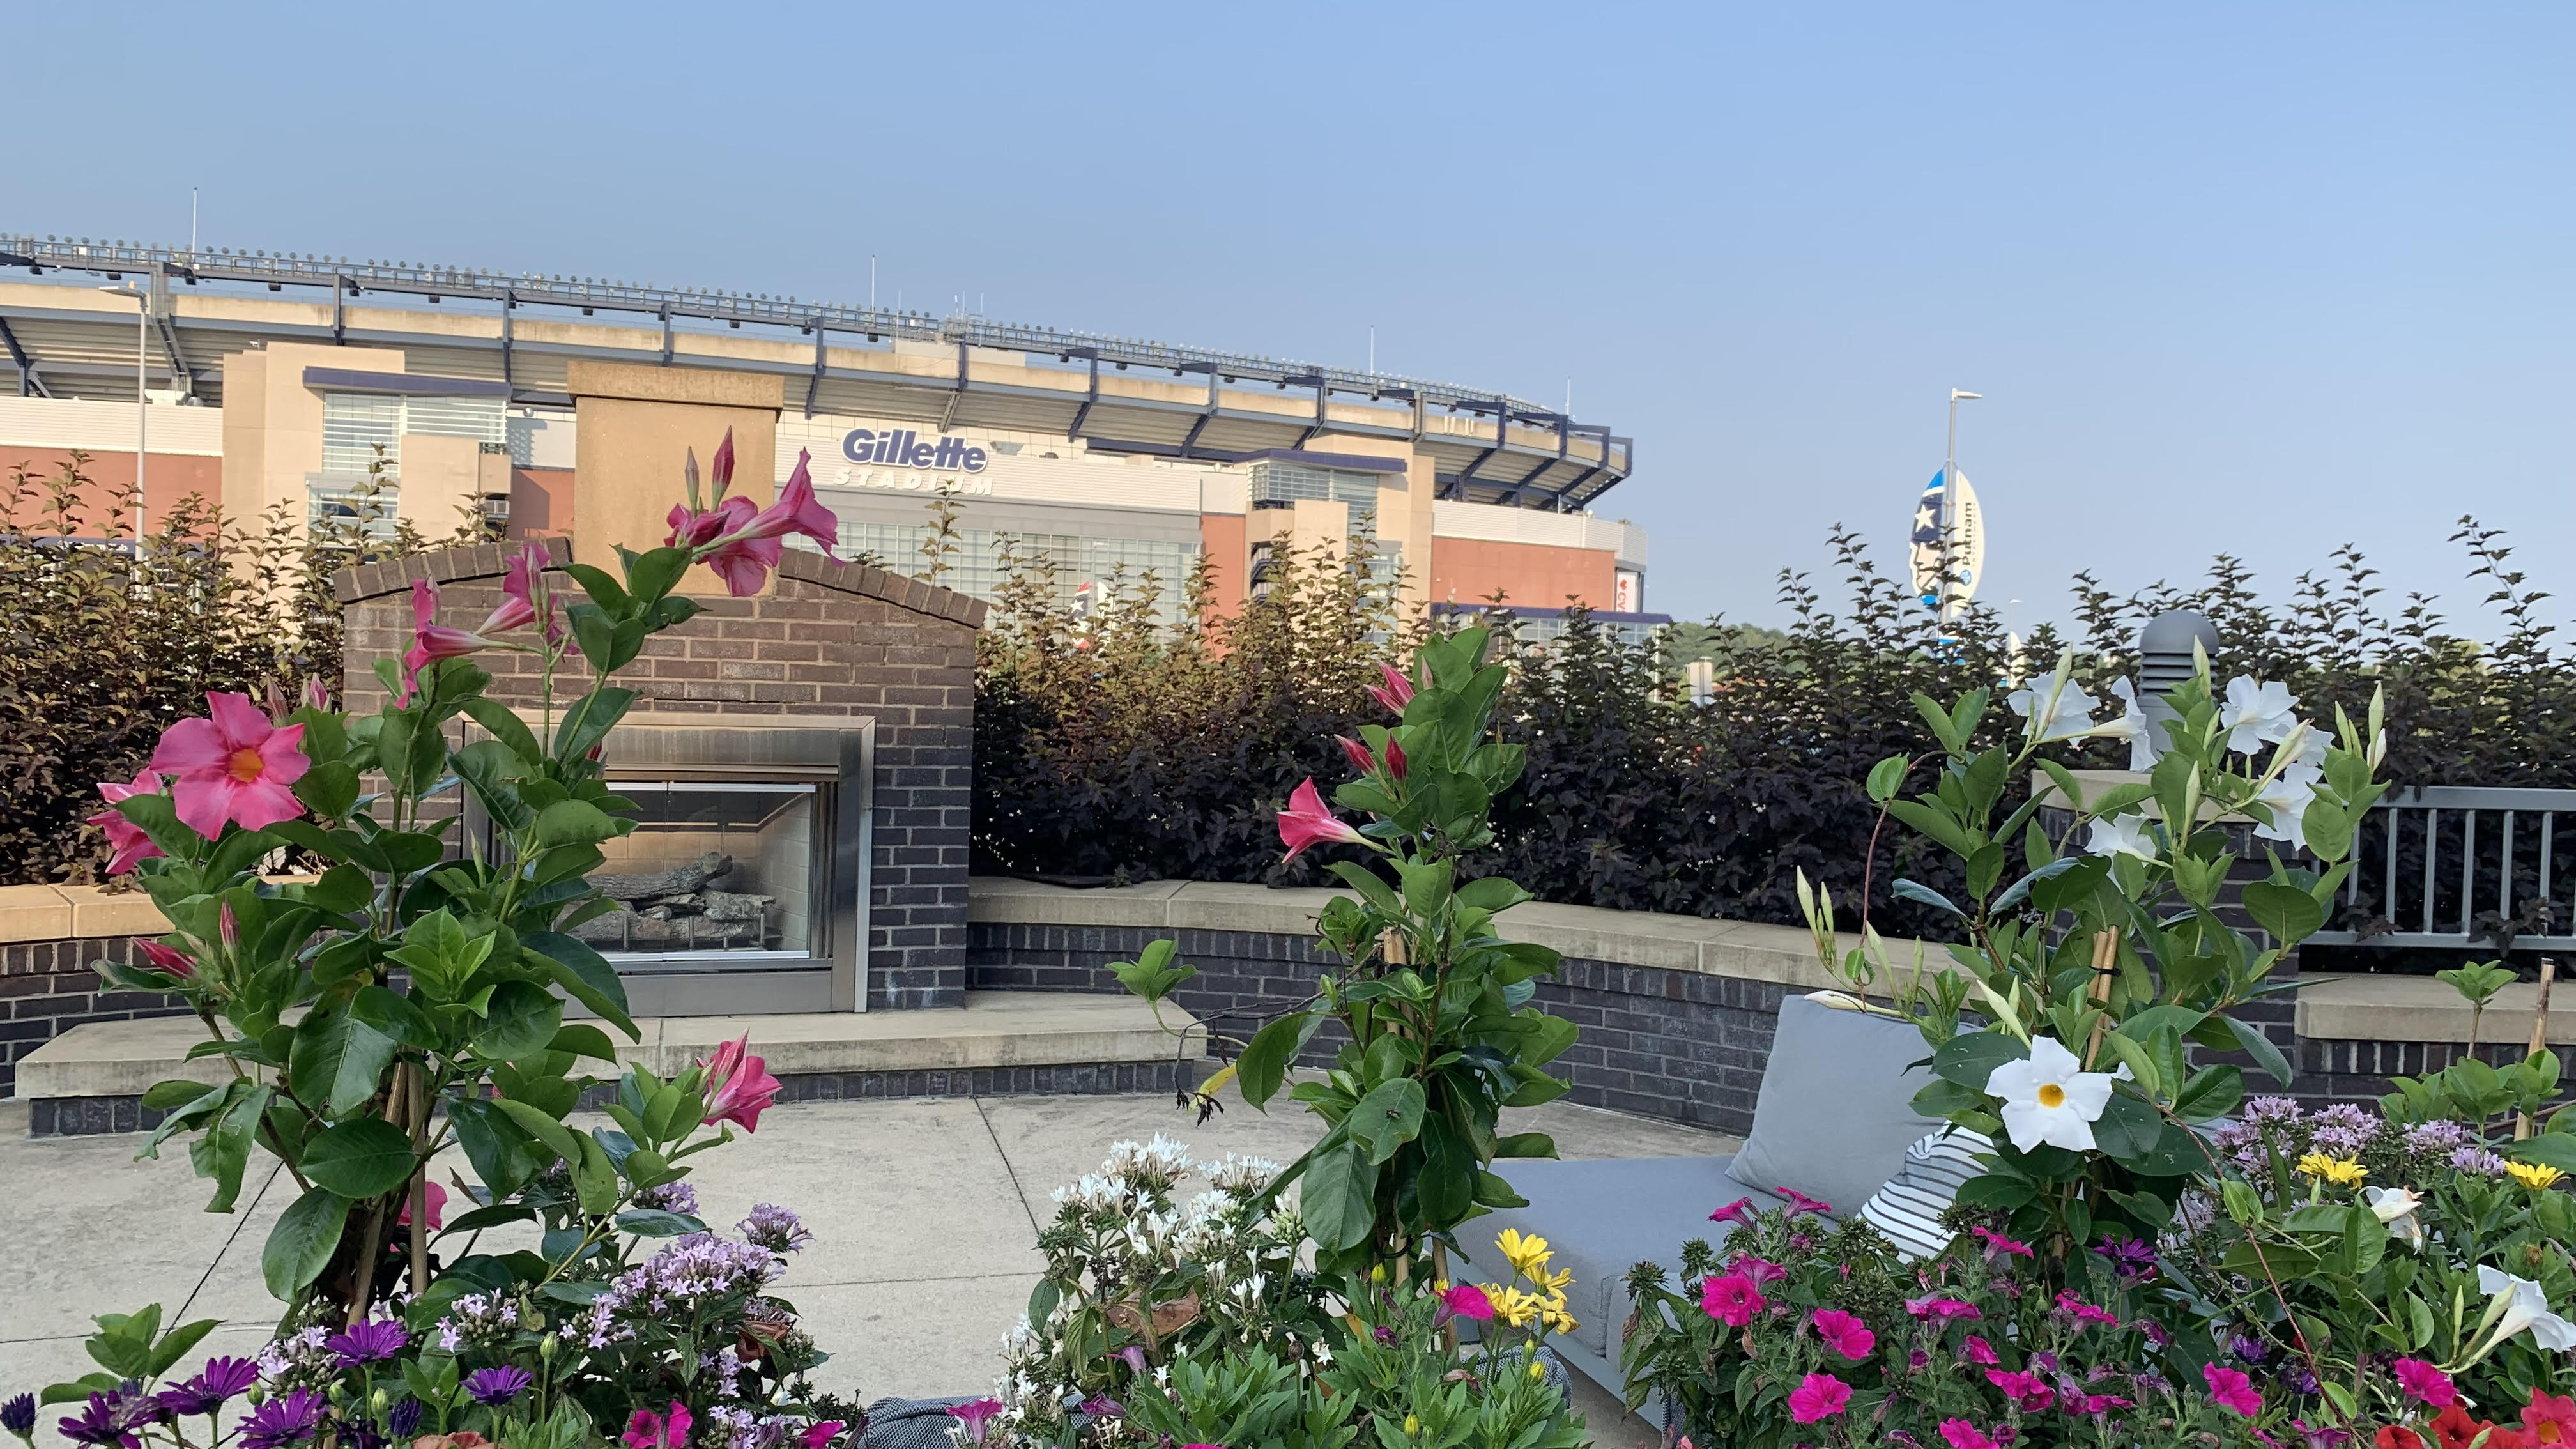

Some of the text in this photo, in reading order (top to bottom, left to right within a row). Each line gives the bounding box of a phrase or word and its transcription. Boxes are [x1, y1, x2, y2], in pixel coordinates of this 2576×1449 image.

[842, 428, 988, 473] Gillette
[833, 467, 992, 495] STADIUM
[1962, 502, 1972, 565] Putnam
[1618, 592, 1626, 613] CV
